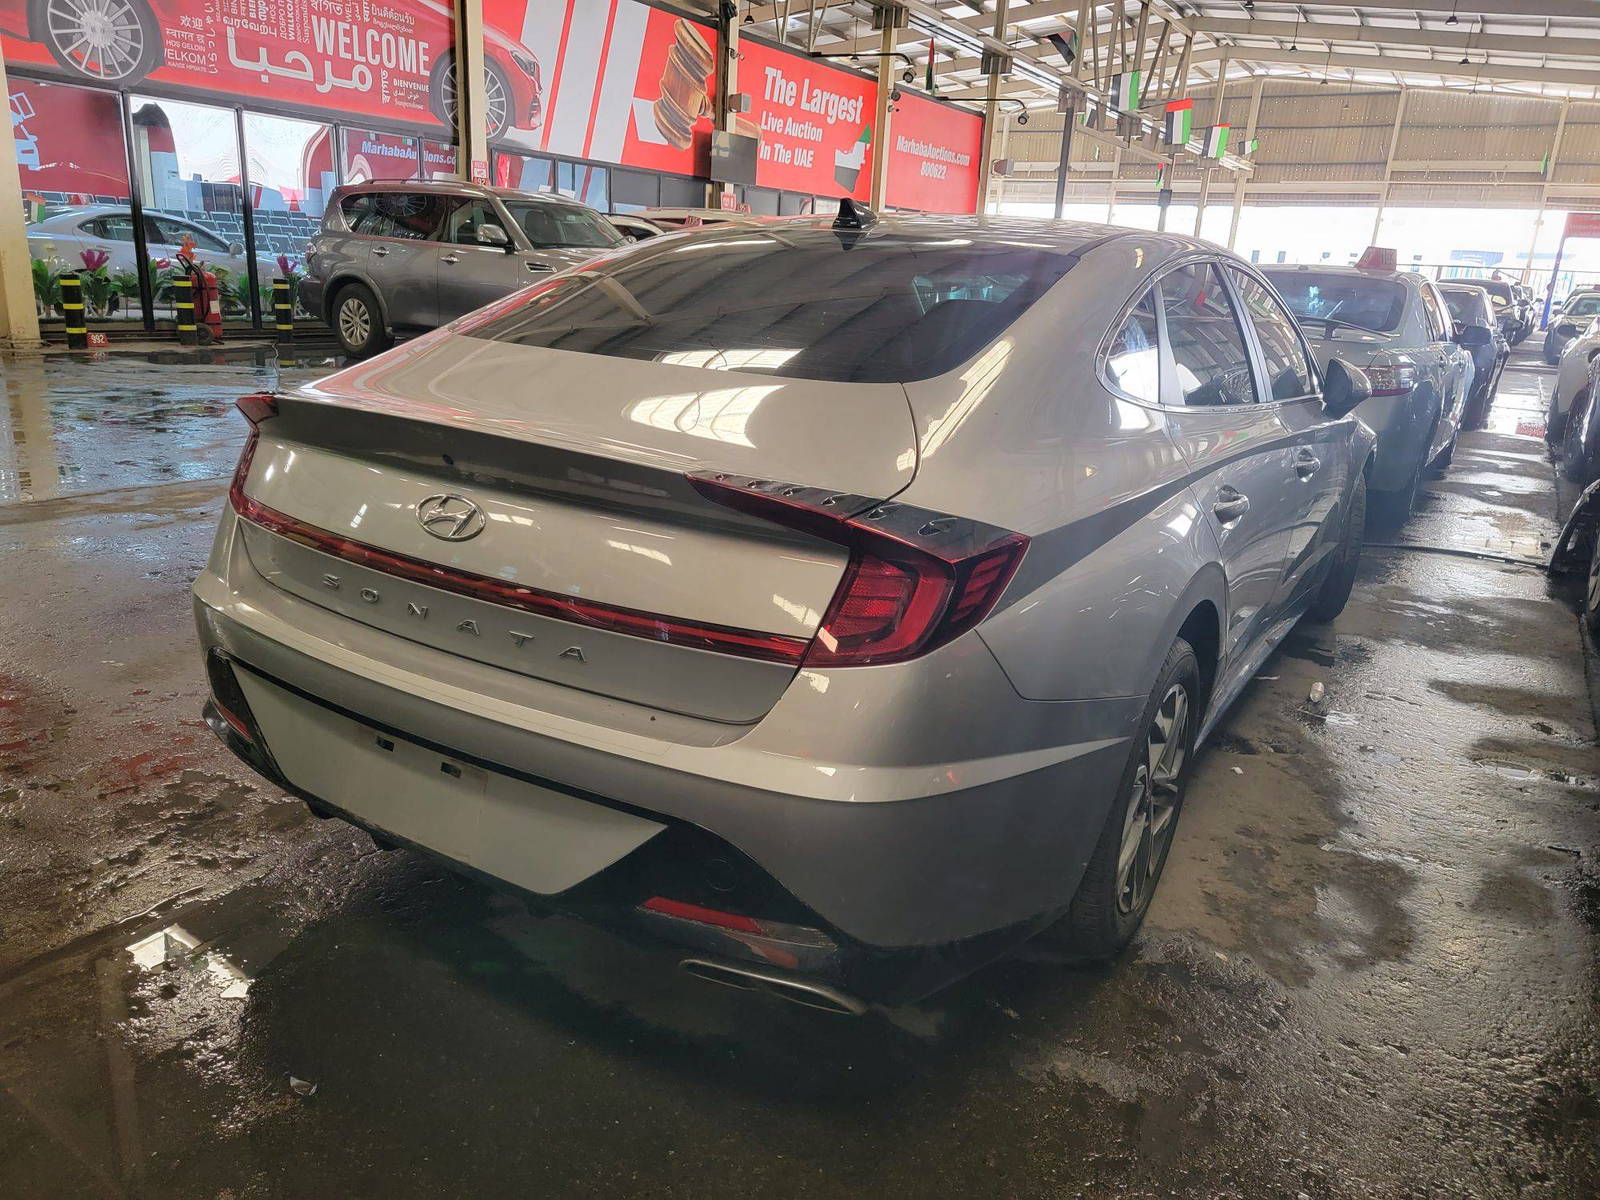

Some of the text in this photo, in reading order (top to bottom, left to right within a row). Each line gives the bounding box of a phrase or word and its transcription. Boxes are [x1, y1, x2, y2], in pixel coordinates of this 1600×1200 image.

[180, 15, 204, 31] 欢迎
[226, 26, 373, 93] مرحبا
[311, 13, 431, 77] WELCOME
[393, 78, 430, 93] BIENVENUE
[764, 66, 863, 125] The Largest
[761, 111, 823, 142] Live Auction
[759, 141, 814, 168] In The UAE
[896, 135, 970, 167] MarhabaAuctions.com
[920, 161, 947, 180] 800622
[322, 573, 587, 664] SONATA
